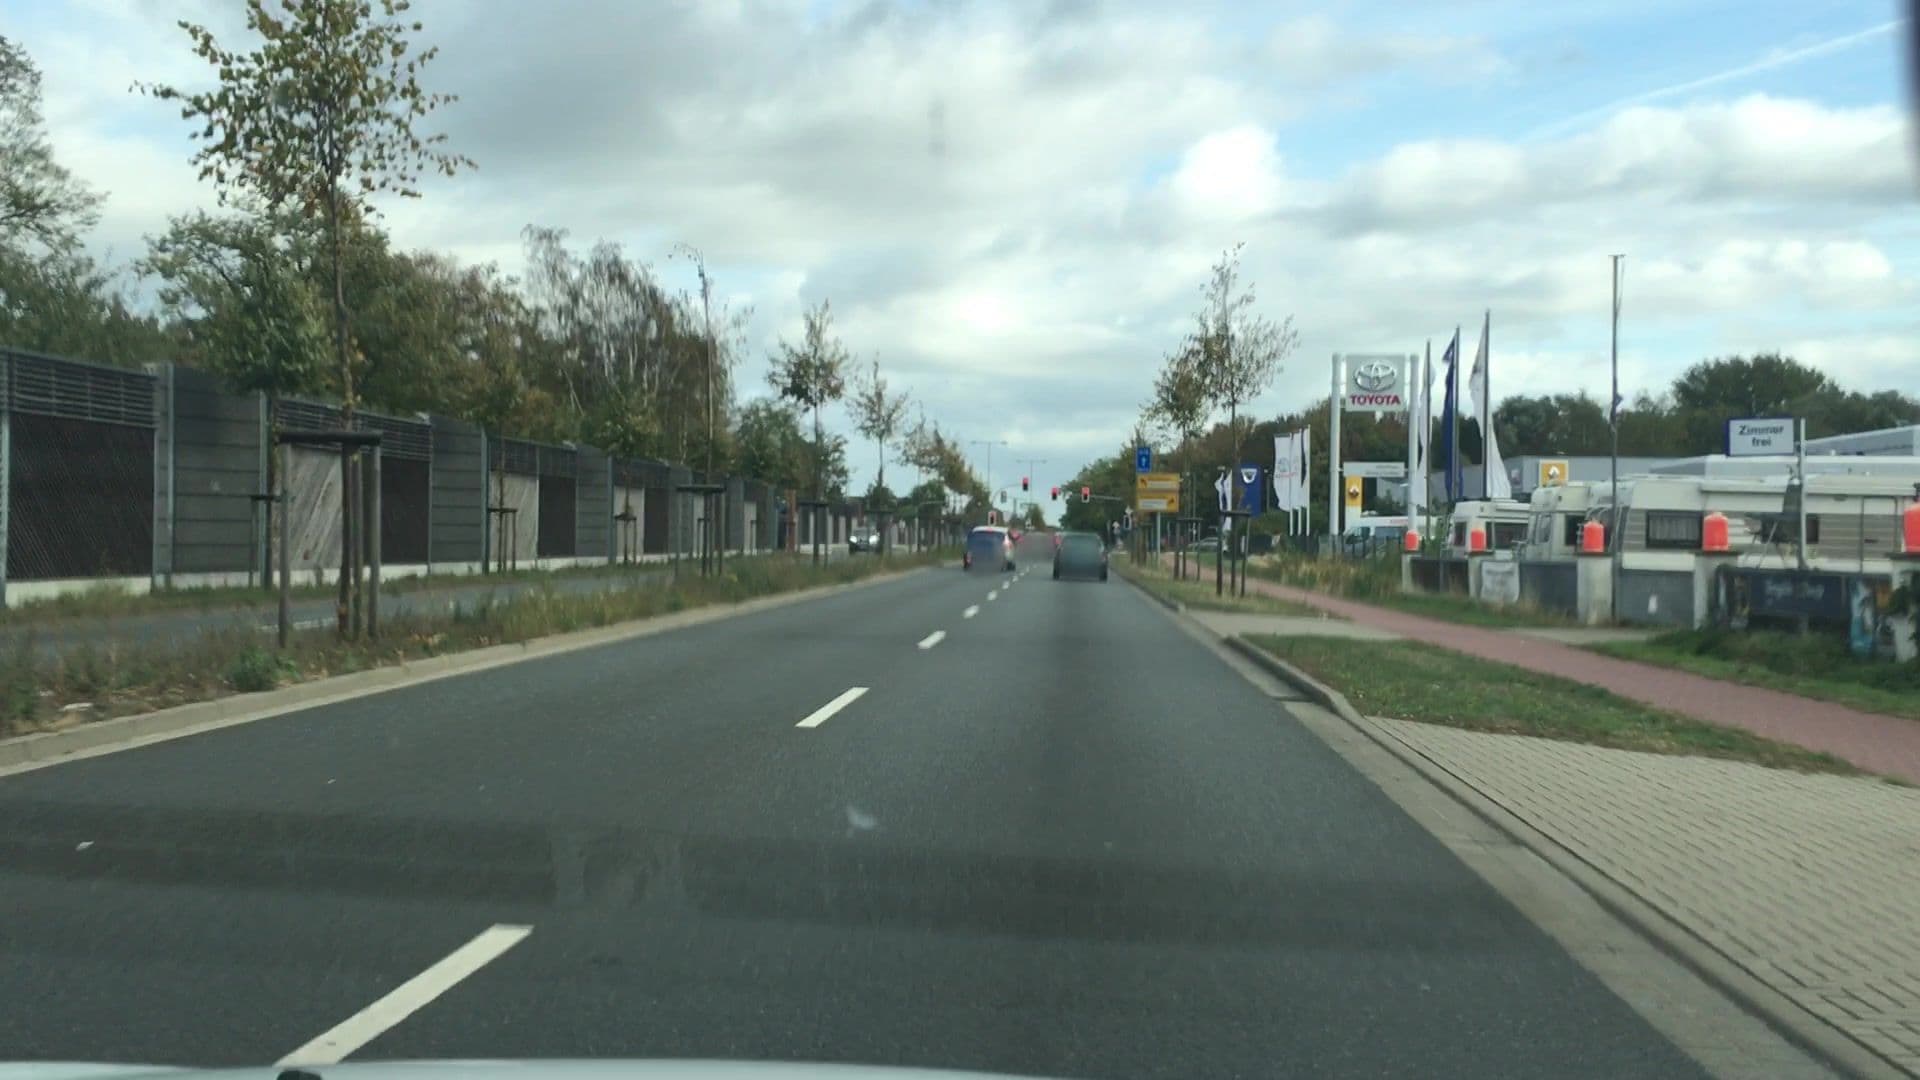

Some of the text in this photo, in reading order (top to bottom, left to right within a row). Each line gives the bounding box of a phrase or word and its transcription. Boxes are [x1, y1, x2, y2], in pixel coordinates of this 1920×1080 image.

[1350, 394, 1401, 405] TOYOTA
[1738, 424, 1785, 436] Zimmer
[1752, 436, 1772, 447] frei
